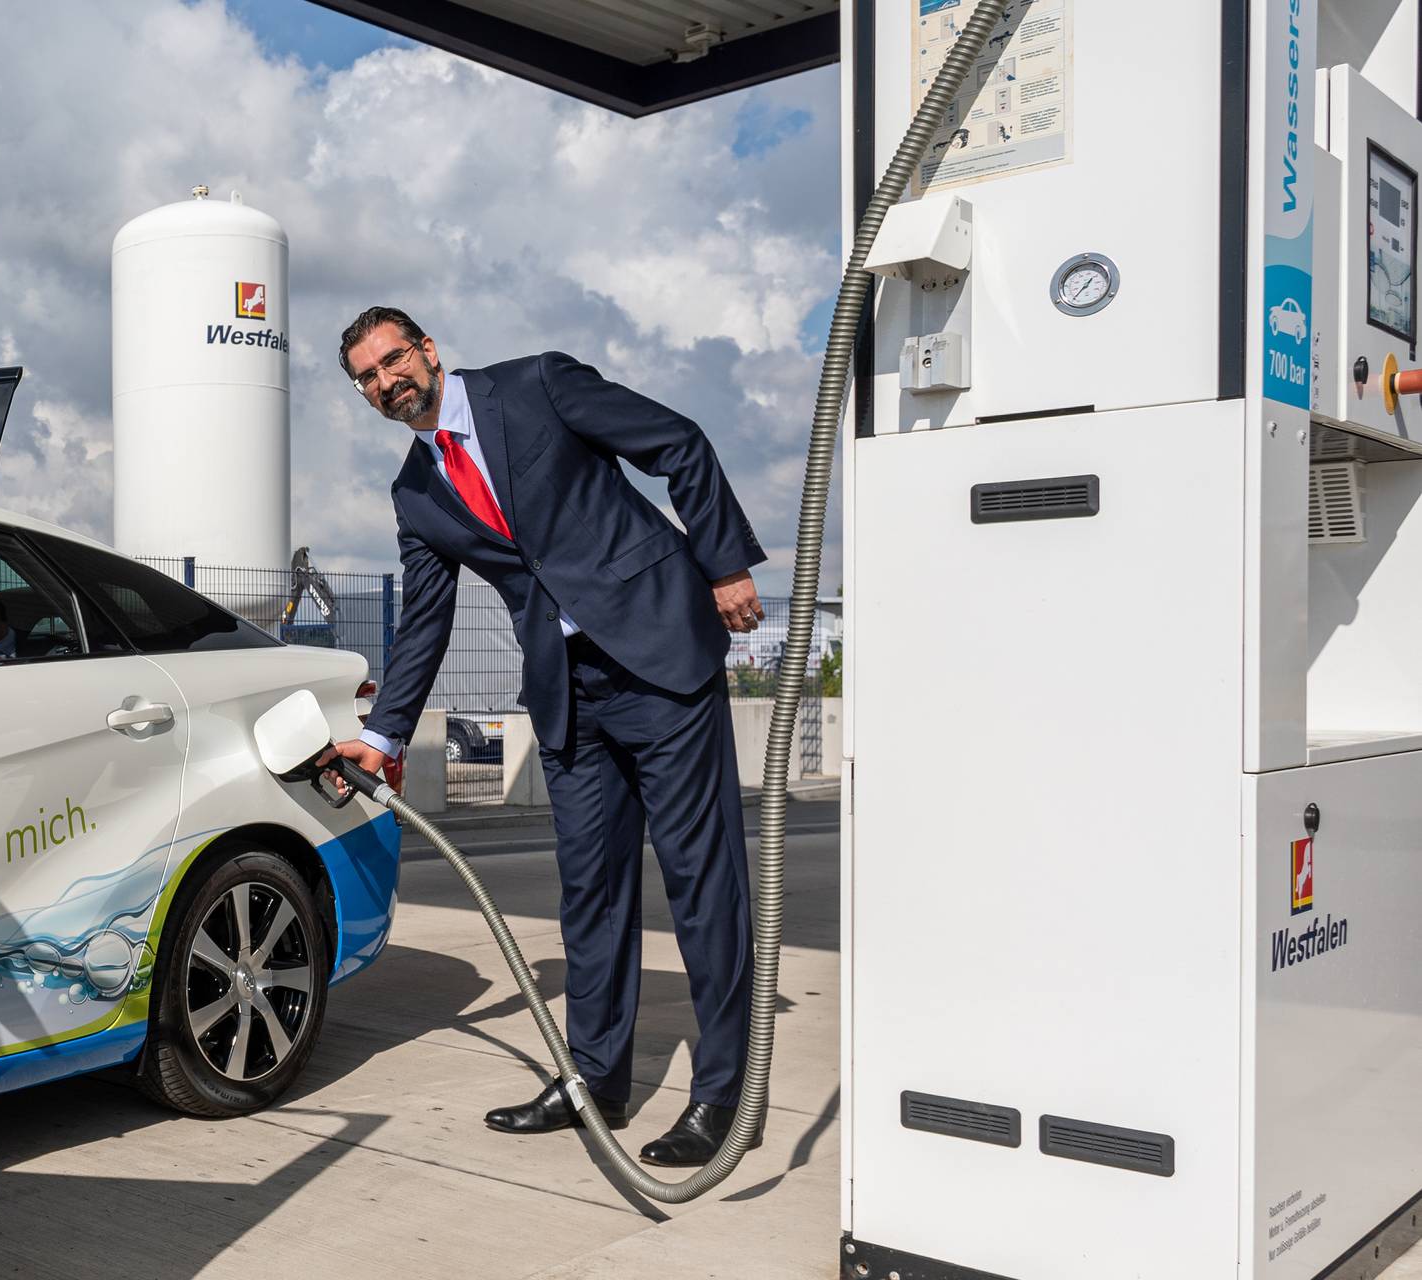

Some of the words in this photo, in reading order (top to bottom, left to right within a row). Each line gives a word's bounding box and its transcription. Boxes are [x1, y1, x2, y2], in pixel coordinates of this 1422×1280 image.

[206, 324, 290, 354] Westfale
[1269, 349, 1288, 380] 700
[1289, 355, 1306, 386] bar
[6, 796, 98, 864] mich.
[1271, 913, 1348, 973] Westfalen
